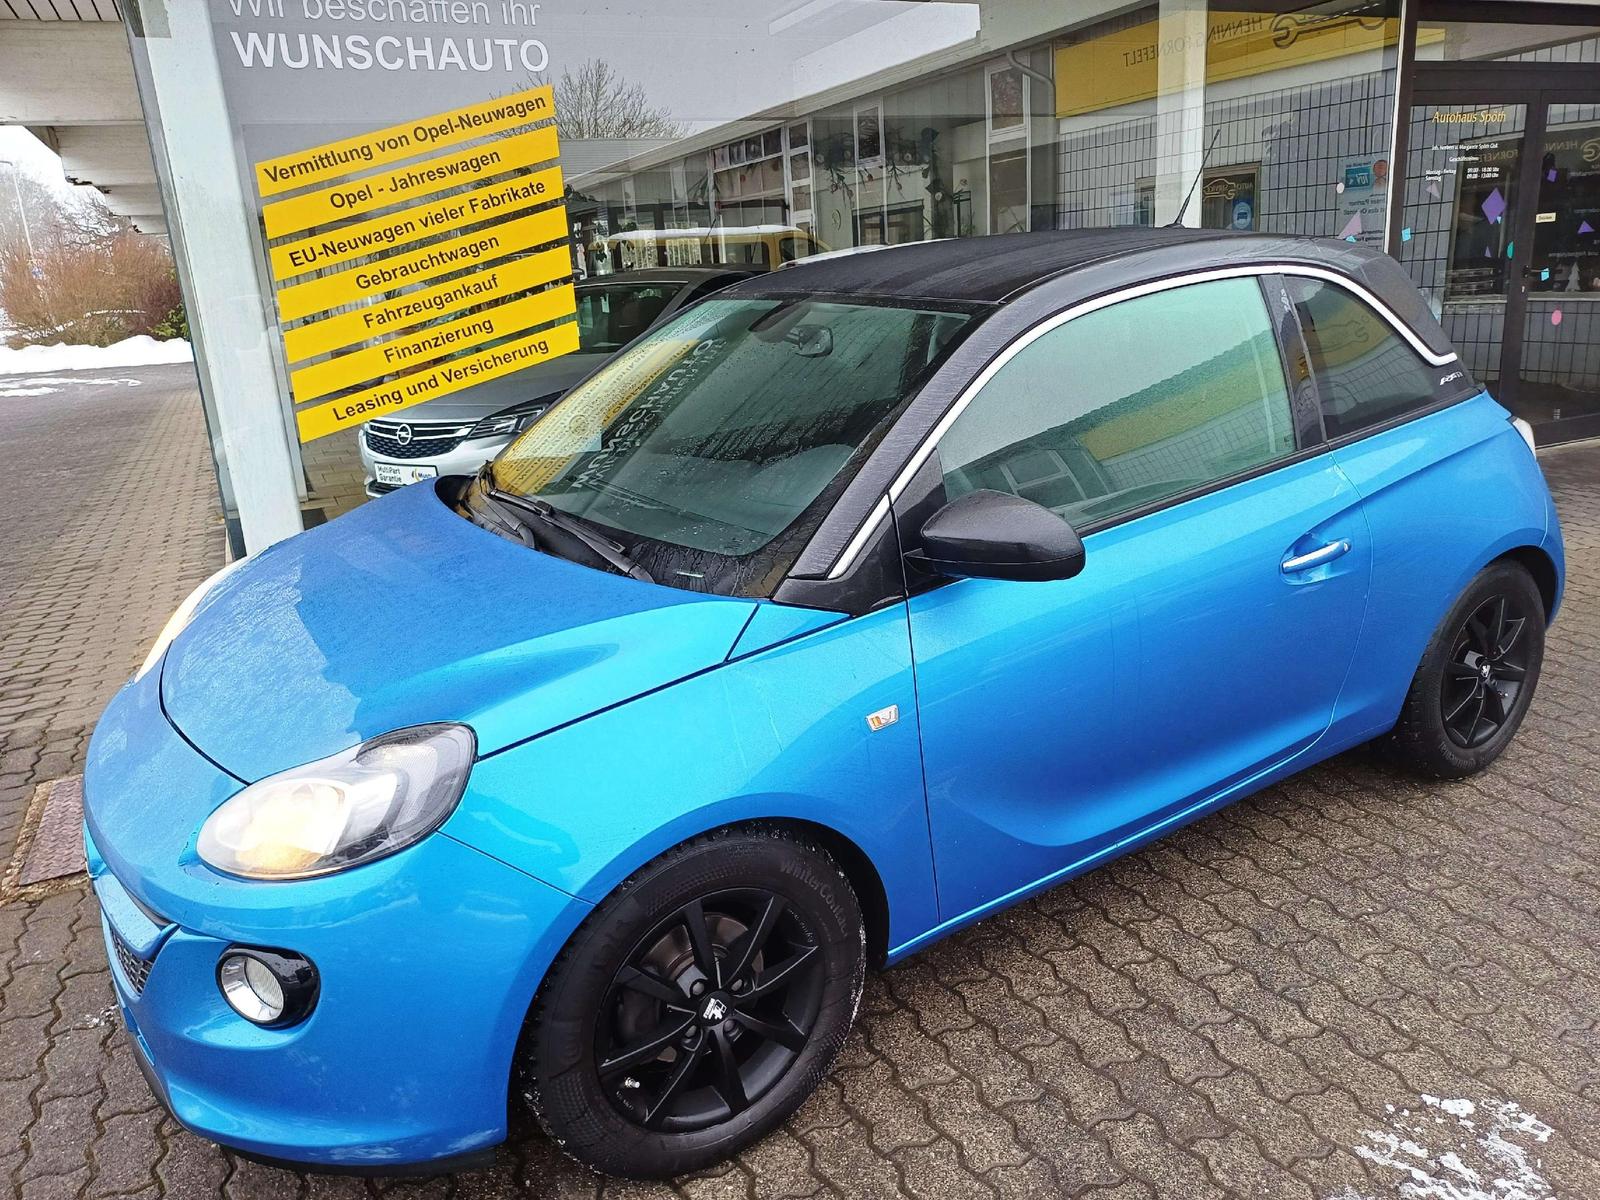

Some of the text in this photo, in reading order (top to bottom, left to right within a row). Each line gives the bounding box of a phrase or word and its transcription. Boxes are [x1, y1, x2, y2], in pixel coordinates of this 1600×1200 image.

[302, 0, 490, 24] beschaffen
[230, 31, 549, 72] WUNSCHAUTO
[263, 94, 547, 183] Vermittlung von Opel-Neuwagen
[1432, 111, 1477, 123] Autohaus
[329, 184, 374, 209] Opel
[388, 151, 501, 194] Jahreswagen
[288, 180, 546, 268] EU-Neuwagen vieler Fabrikate
[355, 236, 501, 291] Gebrauchtwagen
[362, 273, 500, 329] Fahrzeugankauf
[383, 318, 495, 364] Finanzierung
[333, 338, 550, 422] Leasing und Versicherung
